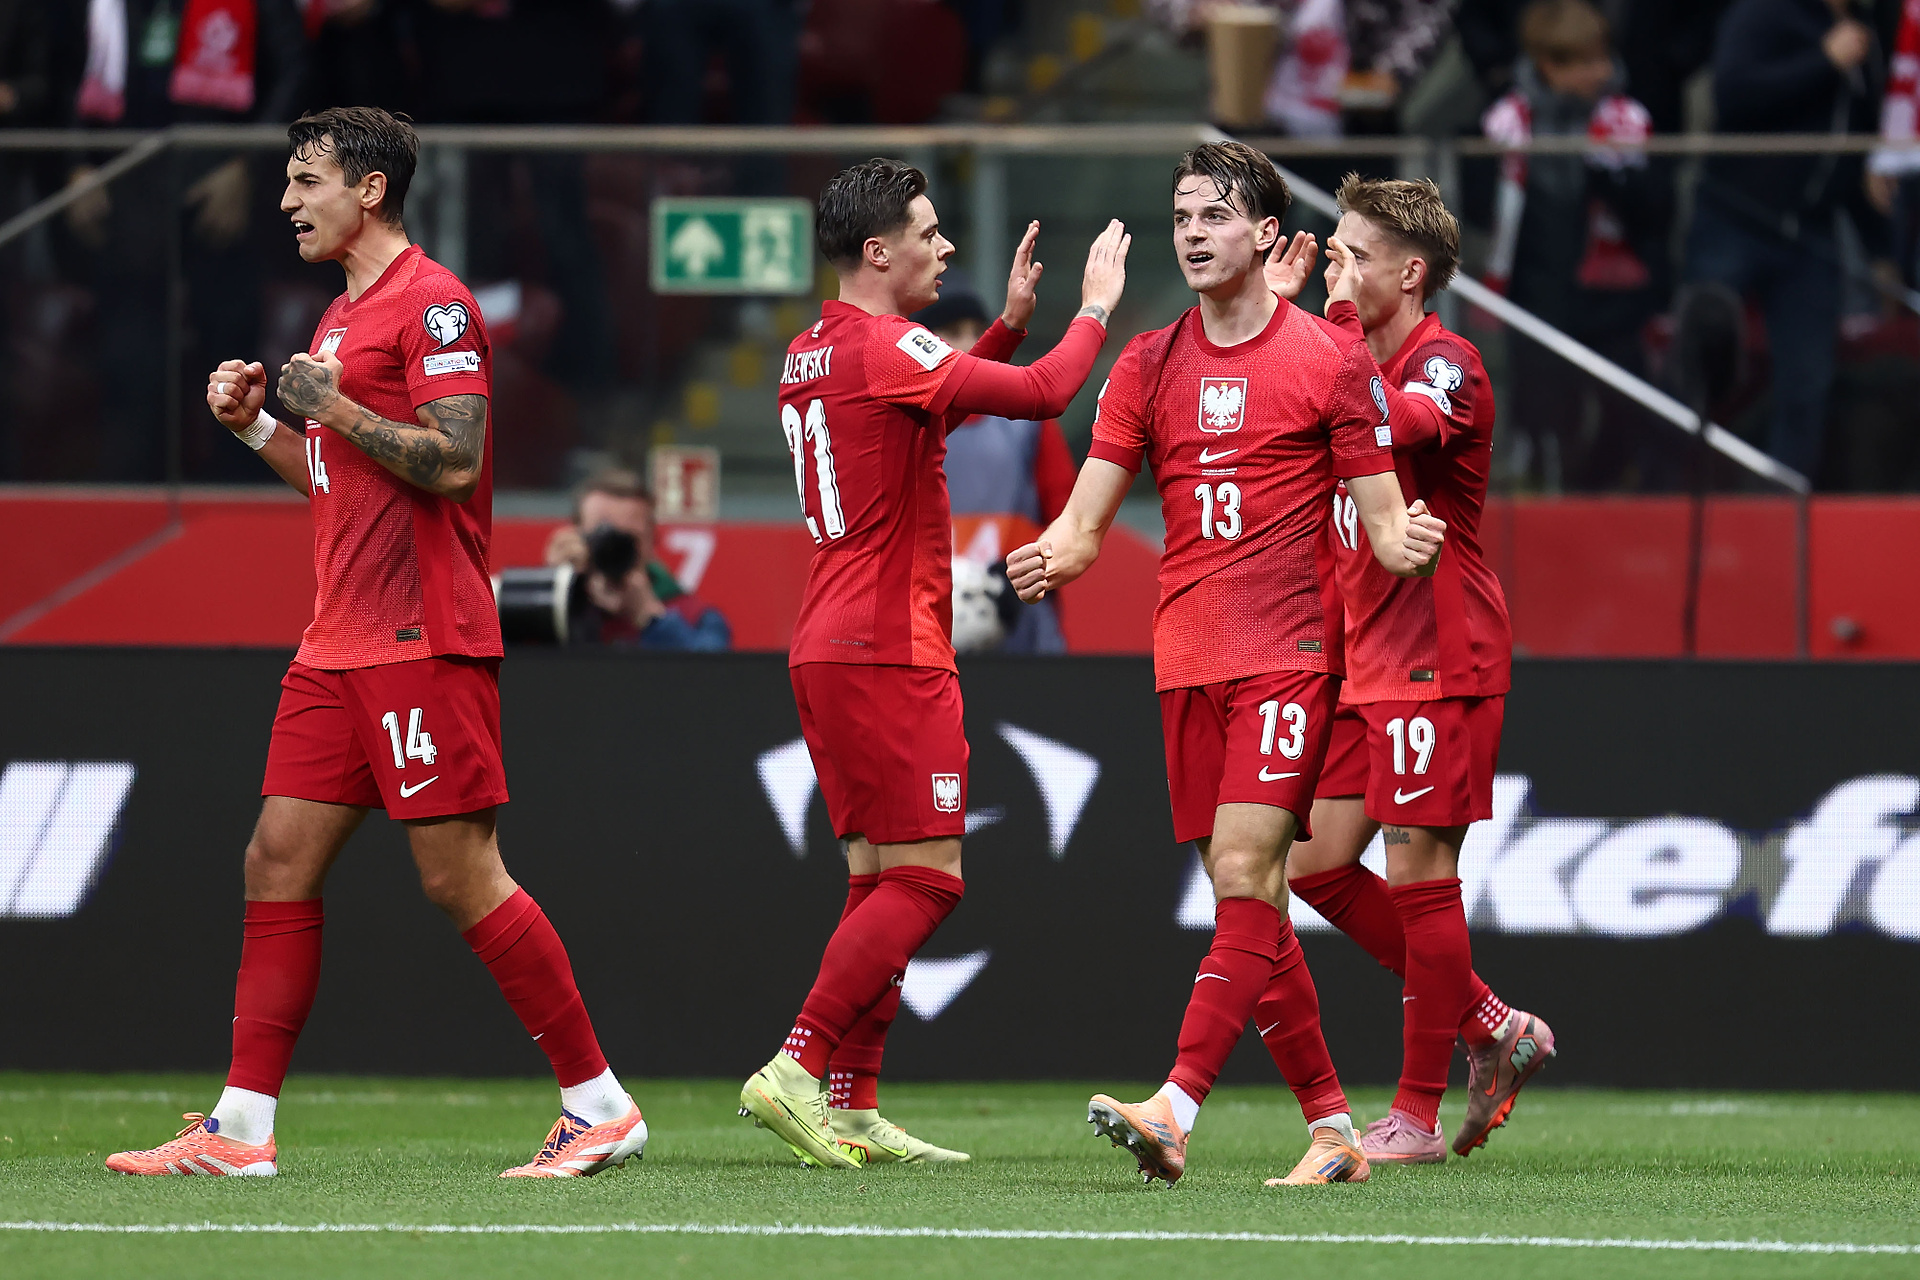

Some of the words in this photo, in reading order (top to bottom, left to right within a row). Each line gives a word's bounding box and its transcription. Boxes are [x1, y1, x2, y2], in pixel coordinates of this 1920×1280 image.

[305, 435, 331, 496] 14
[781, 398, 846, 544] 21
[1194, 481, 1242, 541] 13
[1333, 493, 1359, 552] 19
[664, 529, 716, 594] 7
[381, 707, 438, 769] 14
[1258, 700, 1307, 760] 13
[1386, 716, 1436, 775] 19
